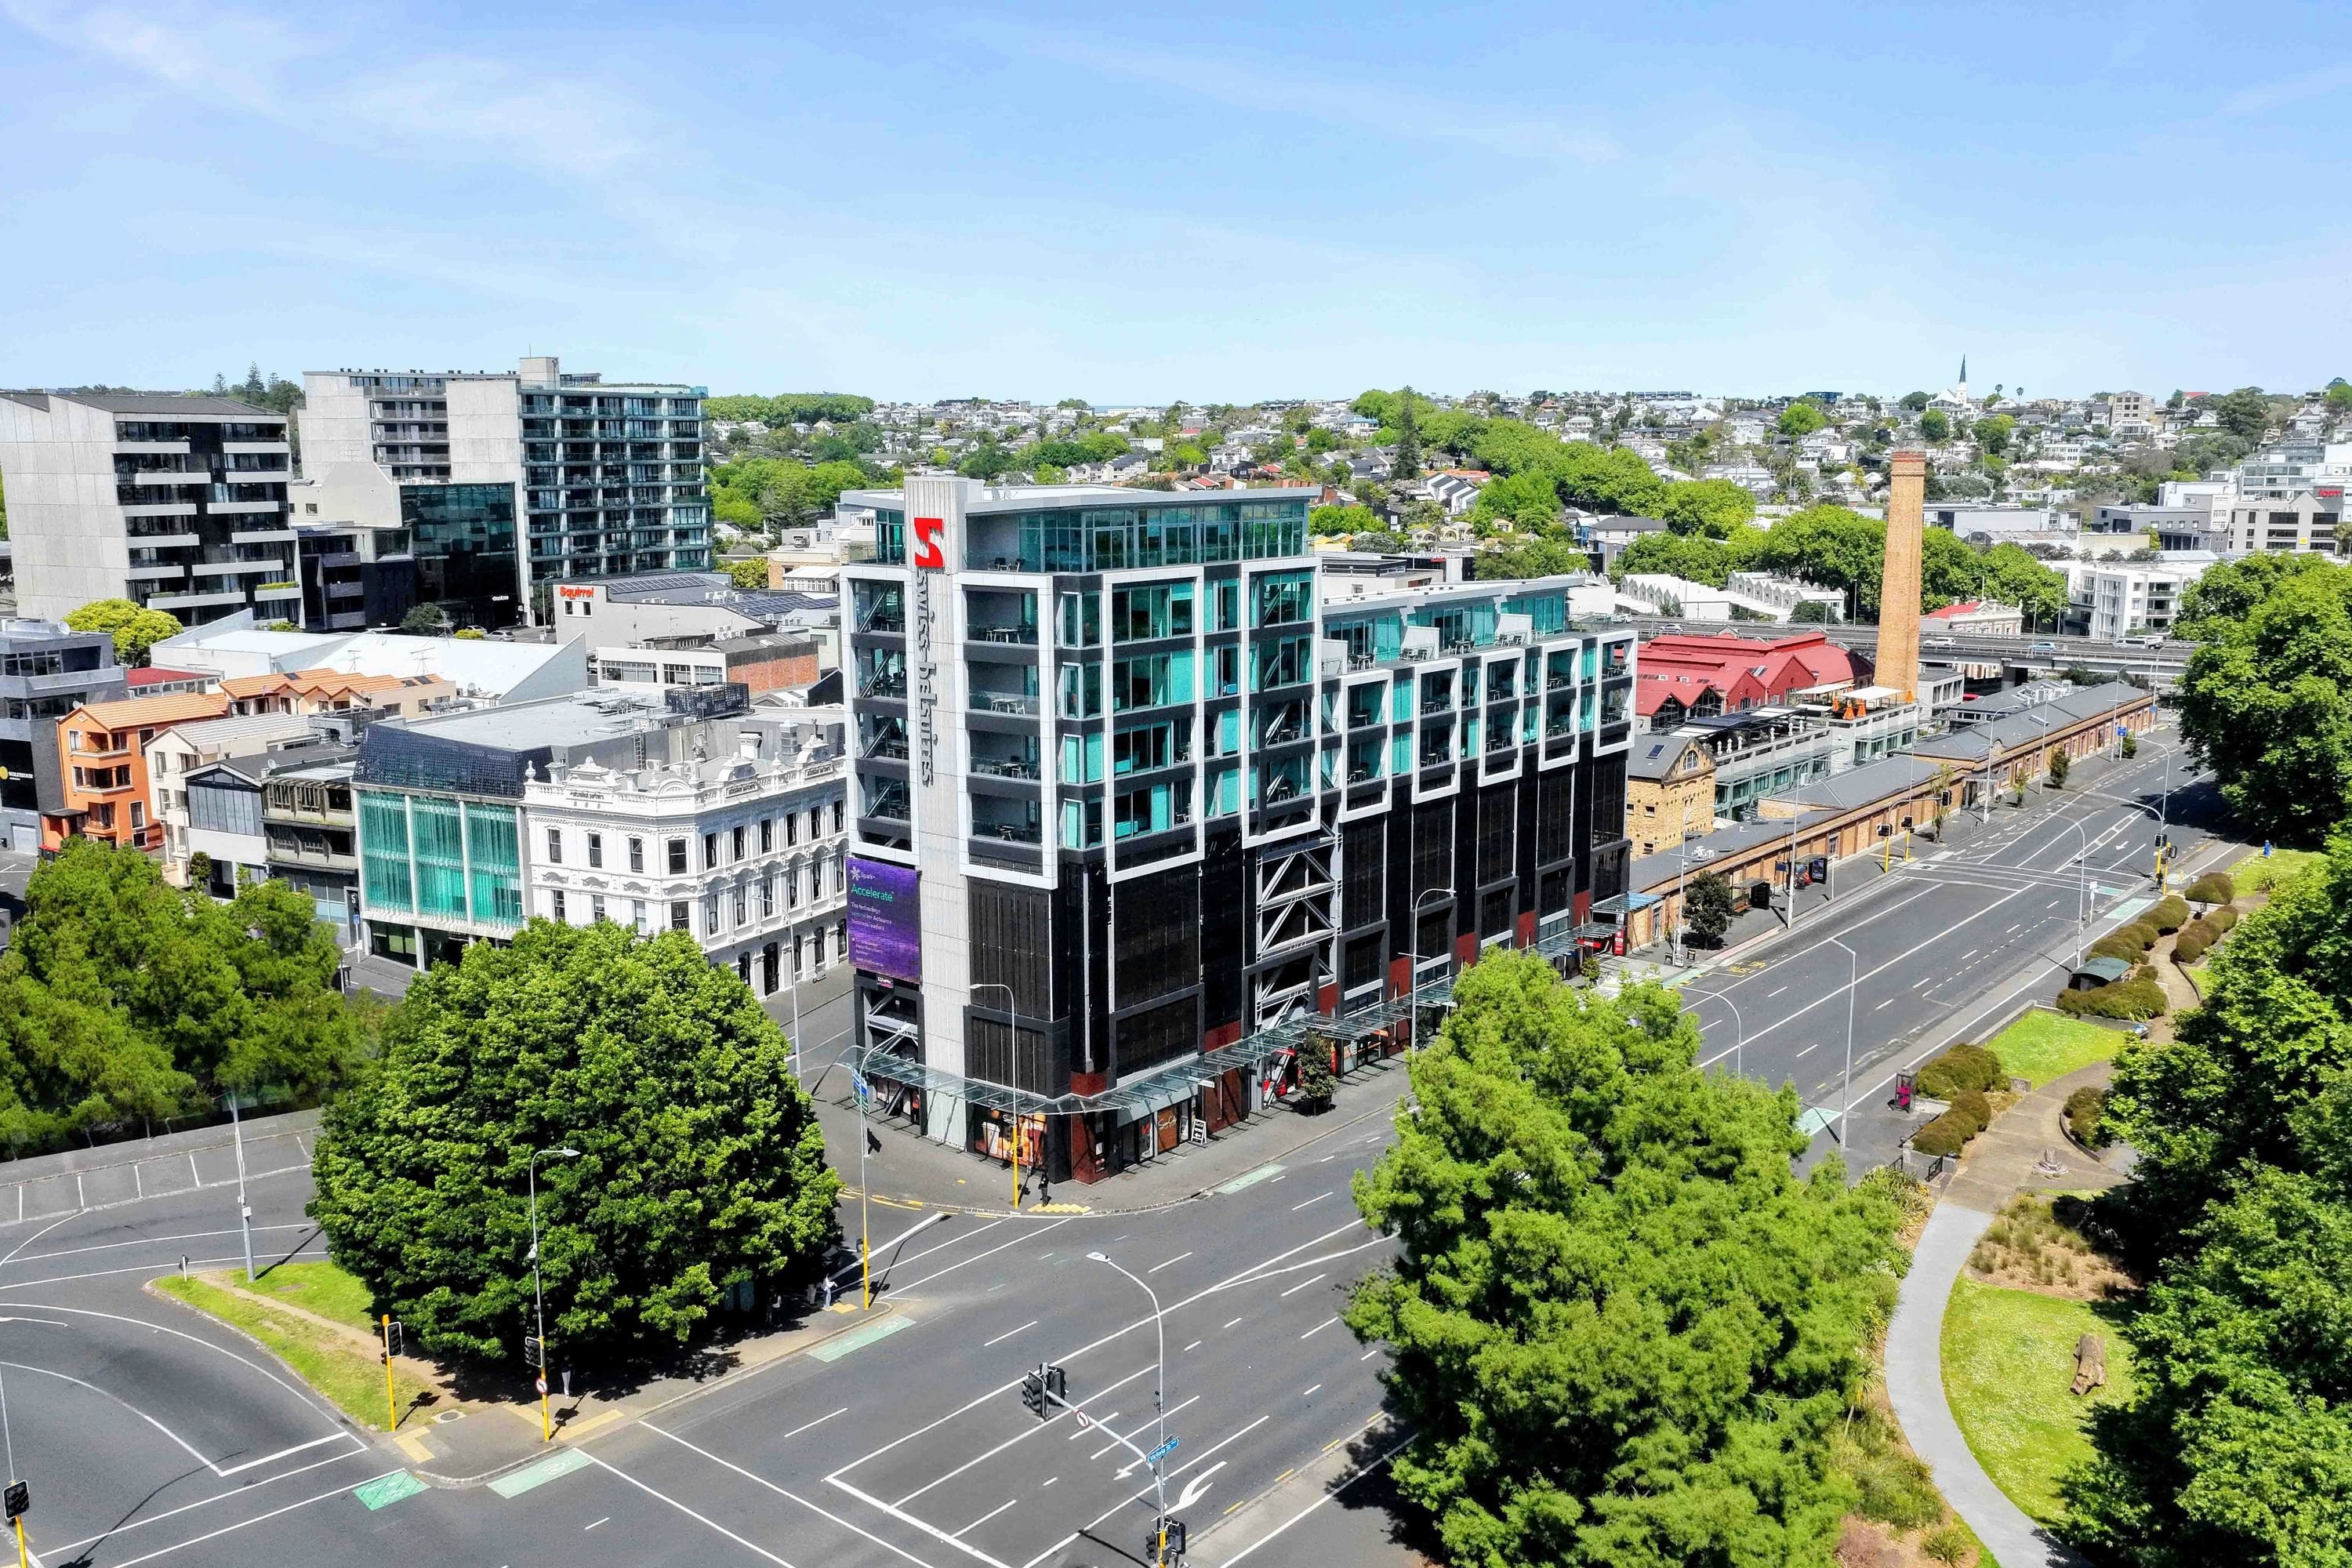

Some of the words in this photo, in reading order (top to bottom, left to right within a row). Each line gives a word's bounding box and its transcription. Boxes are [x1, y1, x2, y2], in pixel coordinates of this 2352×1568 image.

[560, 586, 593, 600] Squirrel
[350, 894, 357, 904] 5
[851, 884, 892, 902] Accelerate
